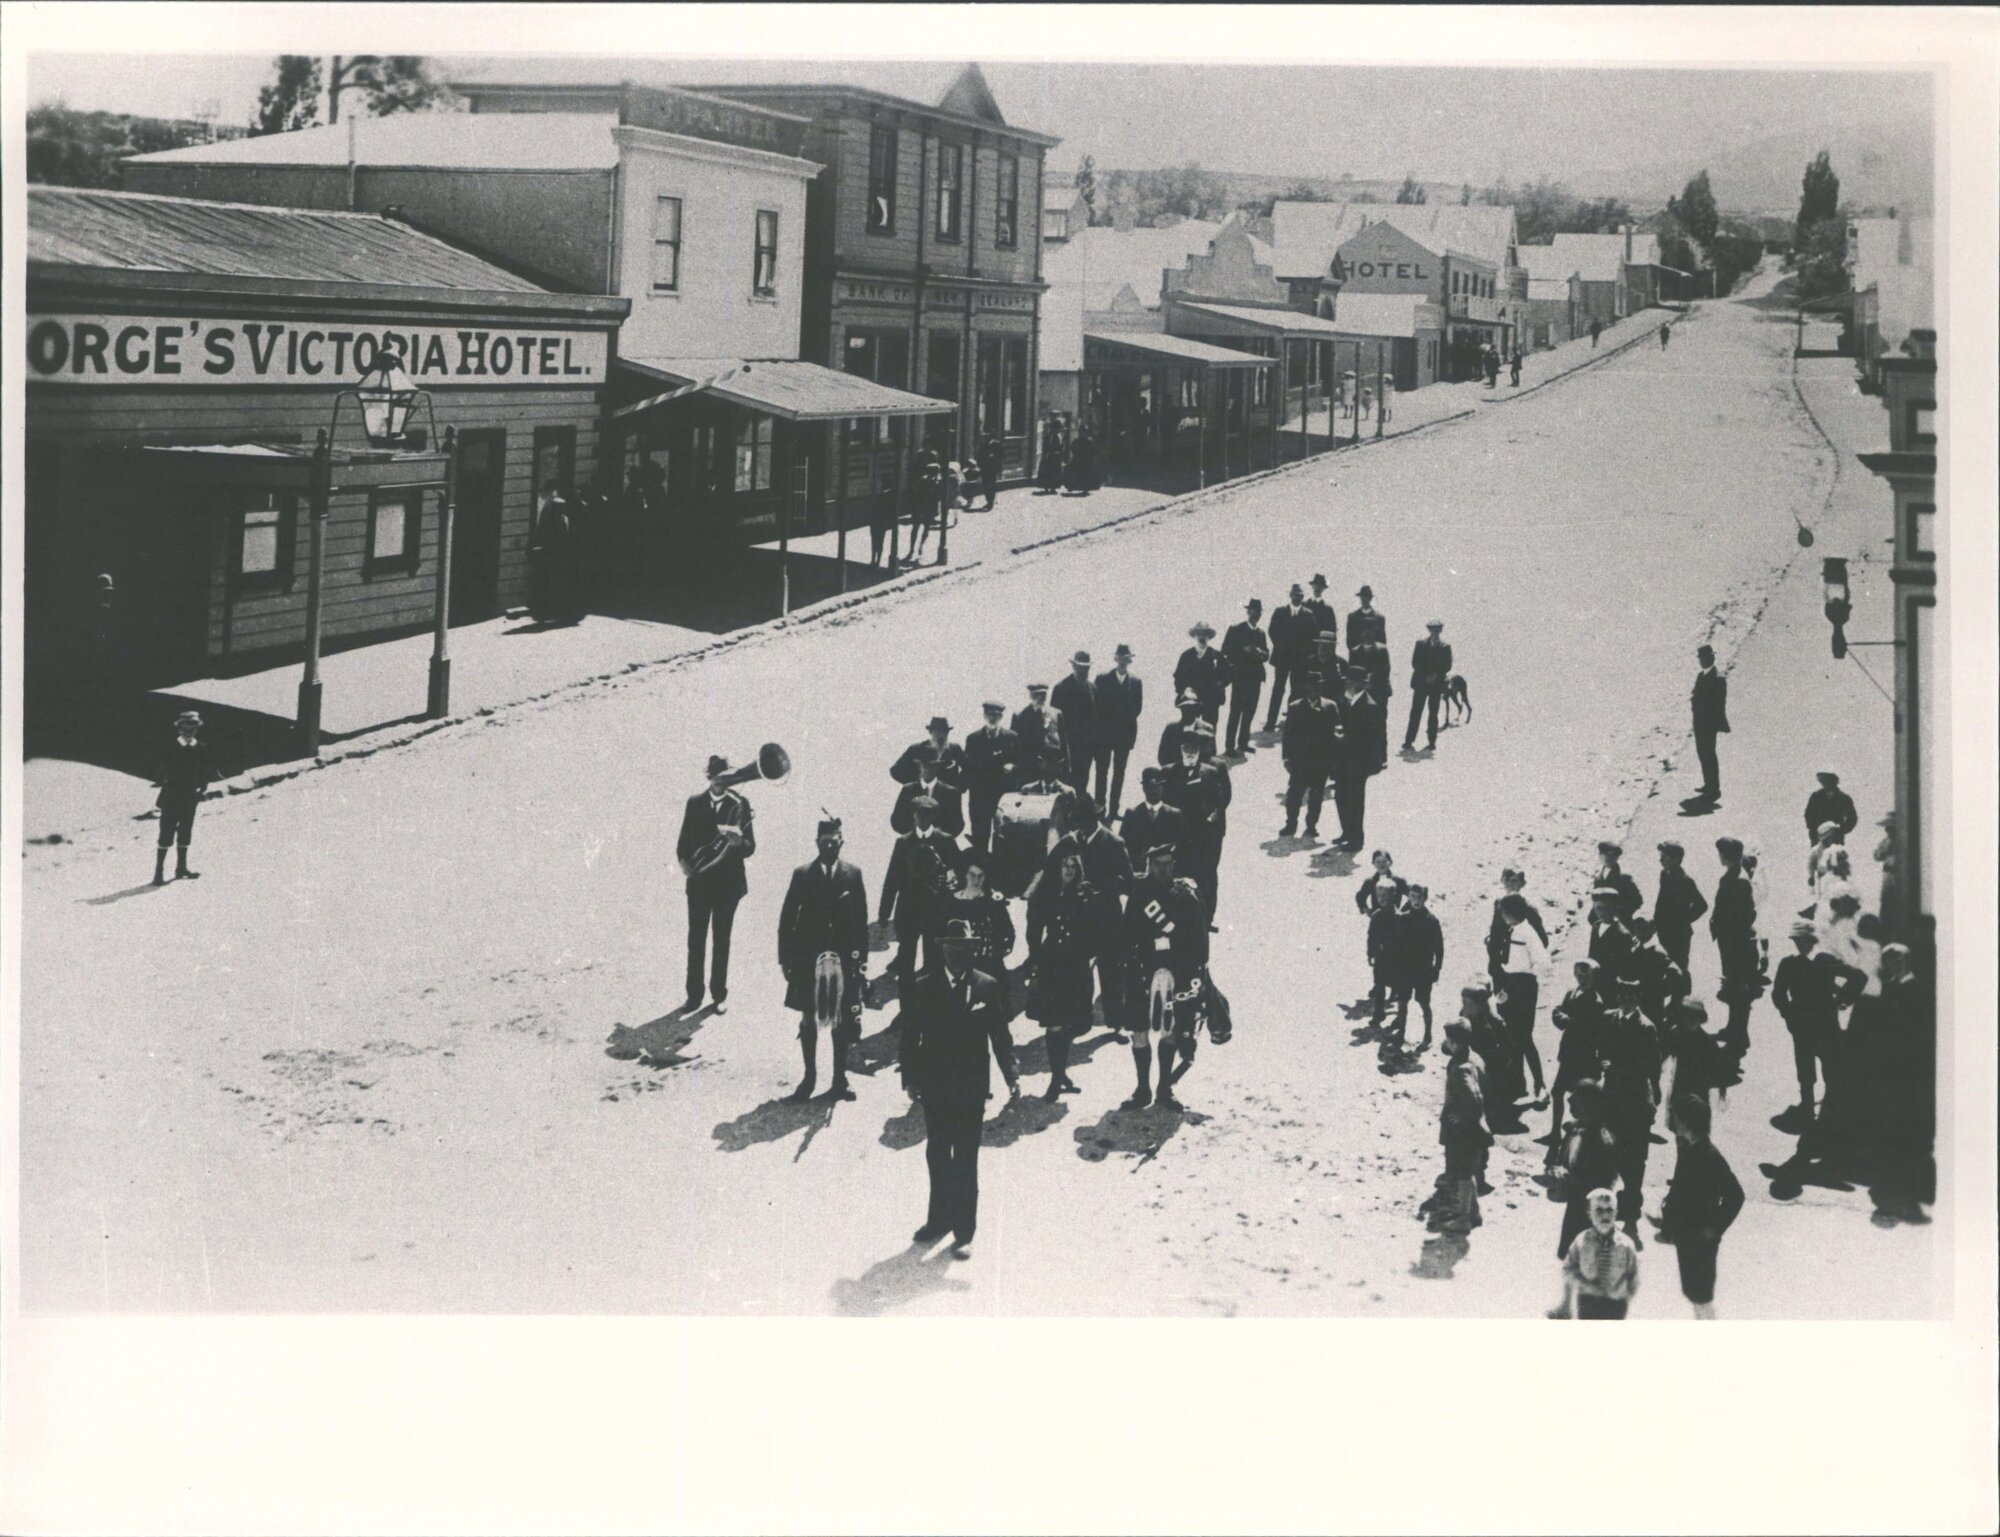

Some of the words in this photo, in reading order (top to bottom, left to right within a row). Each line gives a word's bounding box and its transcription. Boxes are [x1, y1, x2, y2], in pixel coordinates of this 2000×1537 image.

[1340, 261, 1429, 279] HOTEL
[849, 282, 888, 300] BANK
[27, 319, 237, 377] ORGE'S
[243, 324, 448, 376] VICTORIA
[456, 330, 592, 376] HOTEL.
